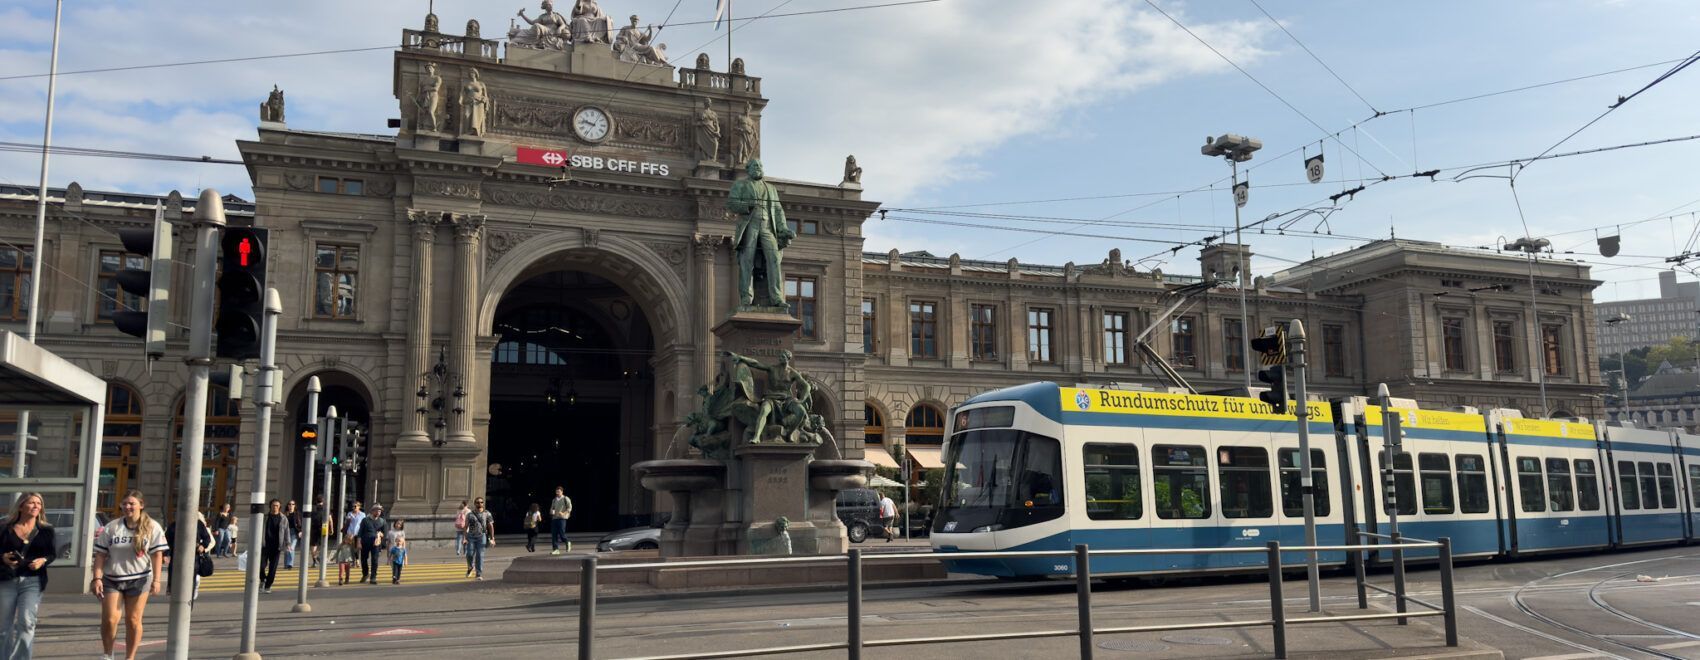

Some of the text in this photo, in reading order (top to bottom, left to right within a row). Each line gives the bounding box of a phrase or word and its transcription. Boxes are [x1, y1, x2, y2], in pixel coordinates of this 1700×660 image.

[571, 155, 669, 176] SBB CFF FFS
[1310, 165, 1321, 177] 18
[1237, 190, 1246, 202] 14
[1099, 391, 1219, 412] Rundumschutz
[1223, 398, 1245, 414] für
